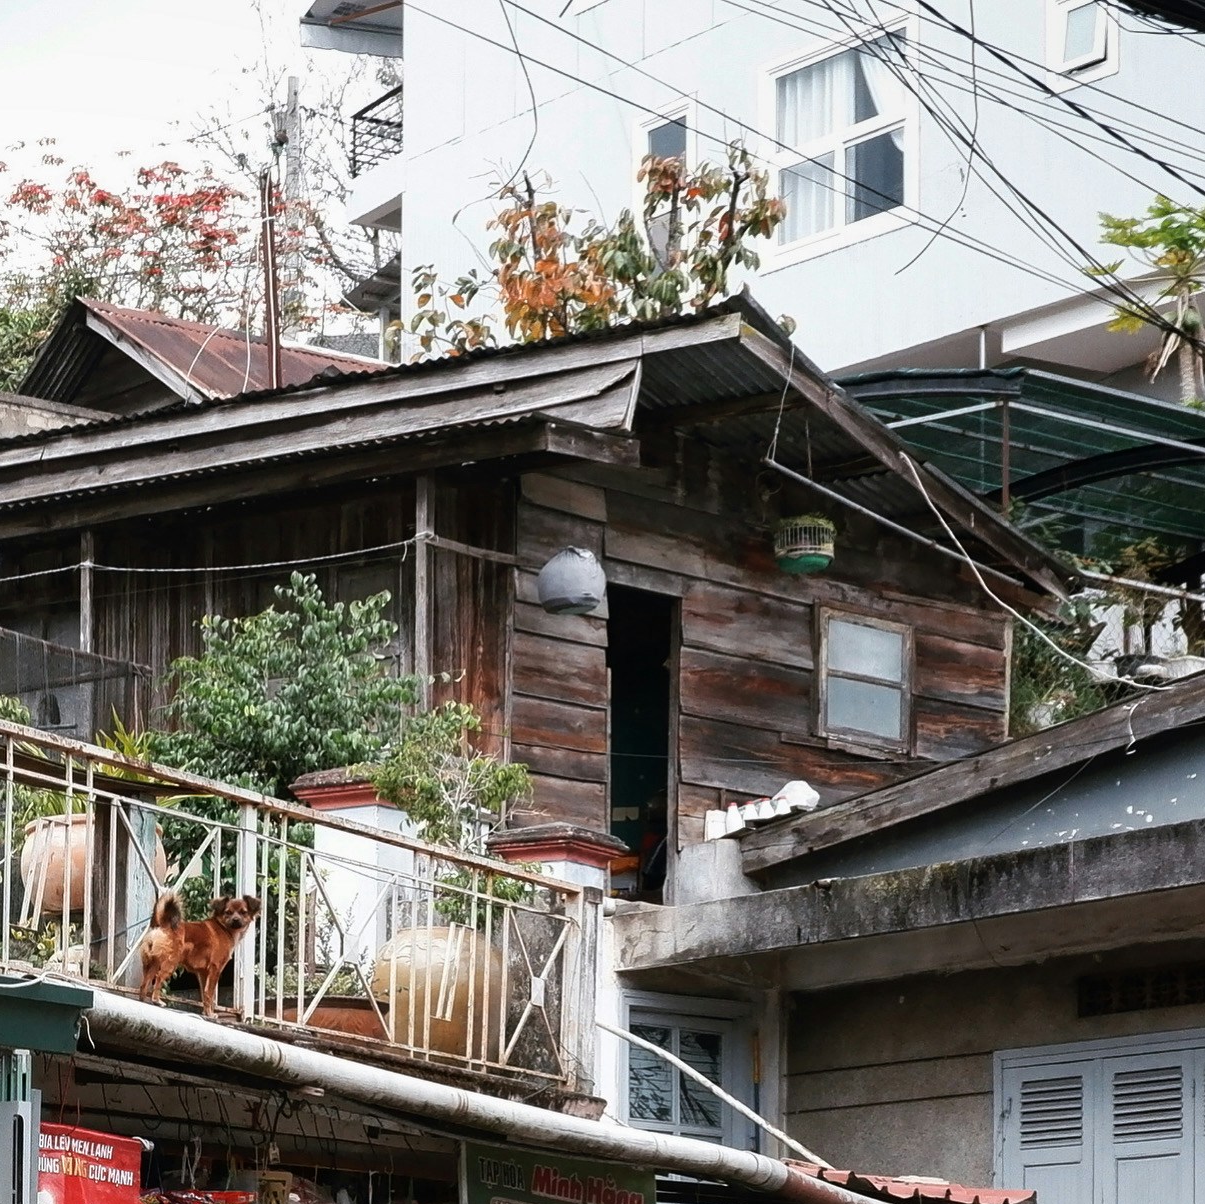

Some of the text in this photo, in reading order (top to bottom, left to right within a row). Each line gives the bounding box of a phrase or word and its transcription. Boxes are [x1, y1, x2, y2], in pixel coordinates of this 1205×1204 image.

[38, 1134, 52, 1149] BIA
[71, 1138, 90, 1155] MEN
[91, 1143, 113, 1160] LẠNH
[88, 1164, 107, 1183] CỰC
[108, 1167, 134, 1187] MẠNH
[478, 1156, 500, 1189] TẠP
[531, 1163, 583, 1204] Minh
